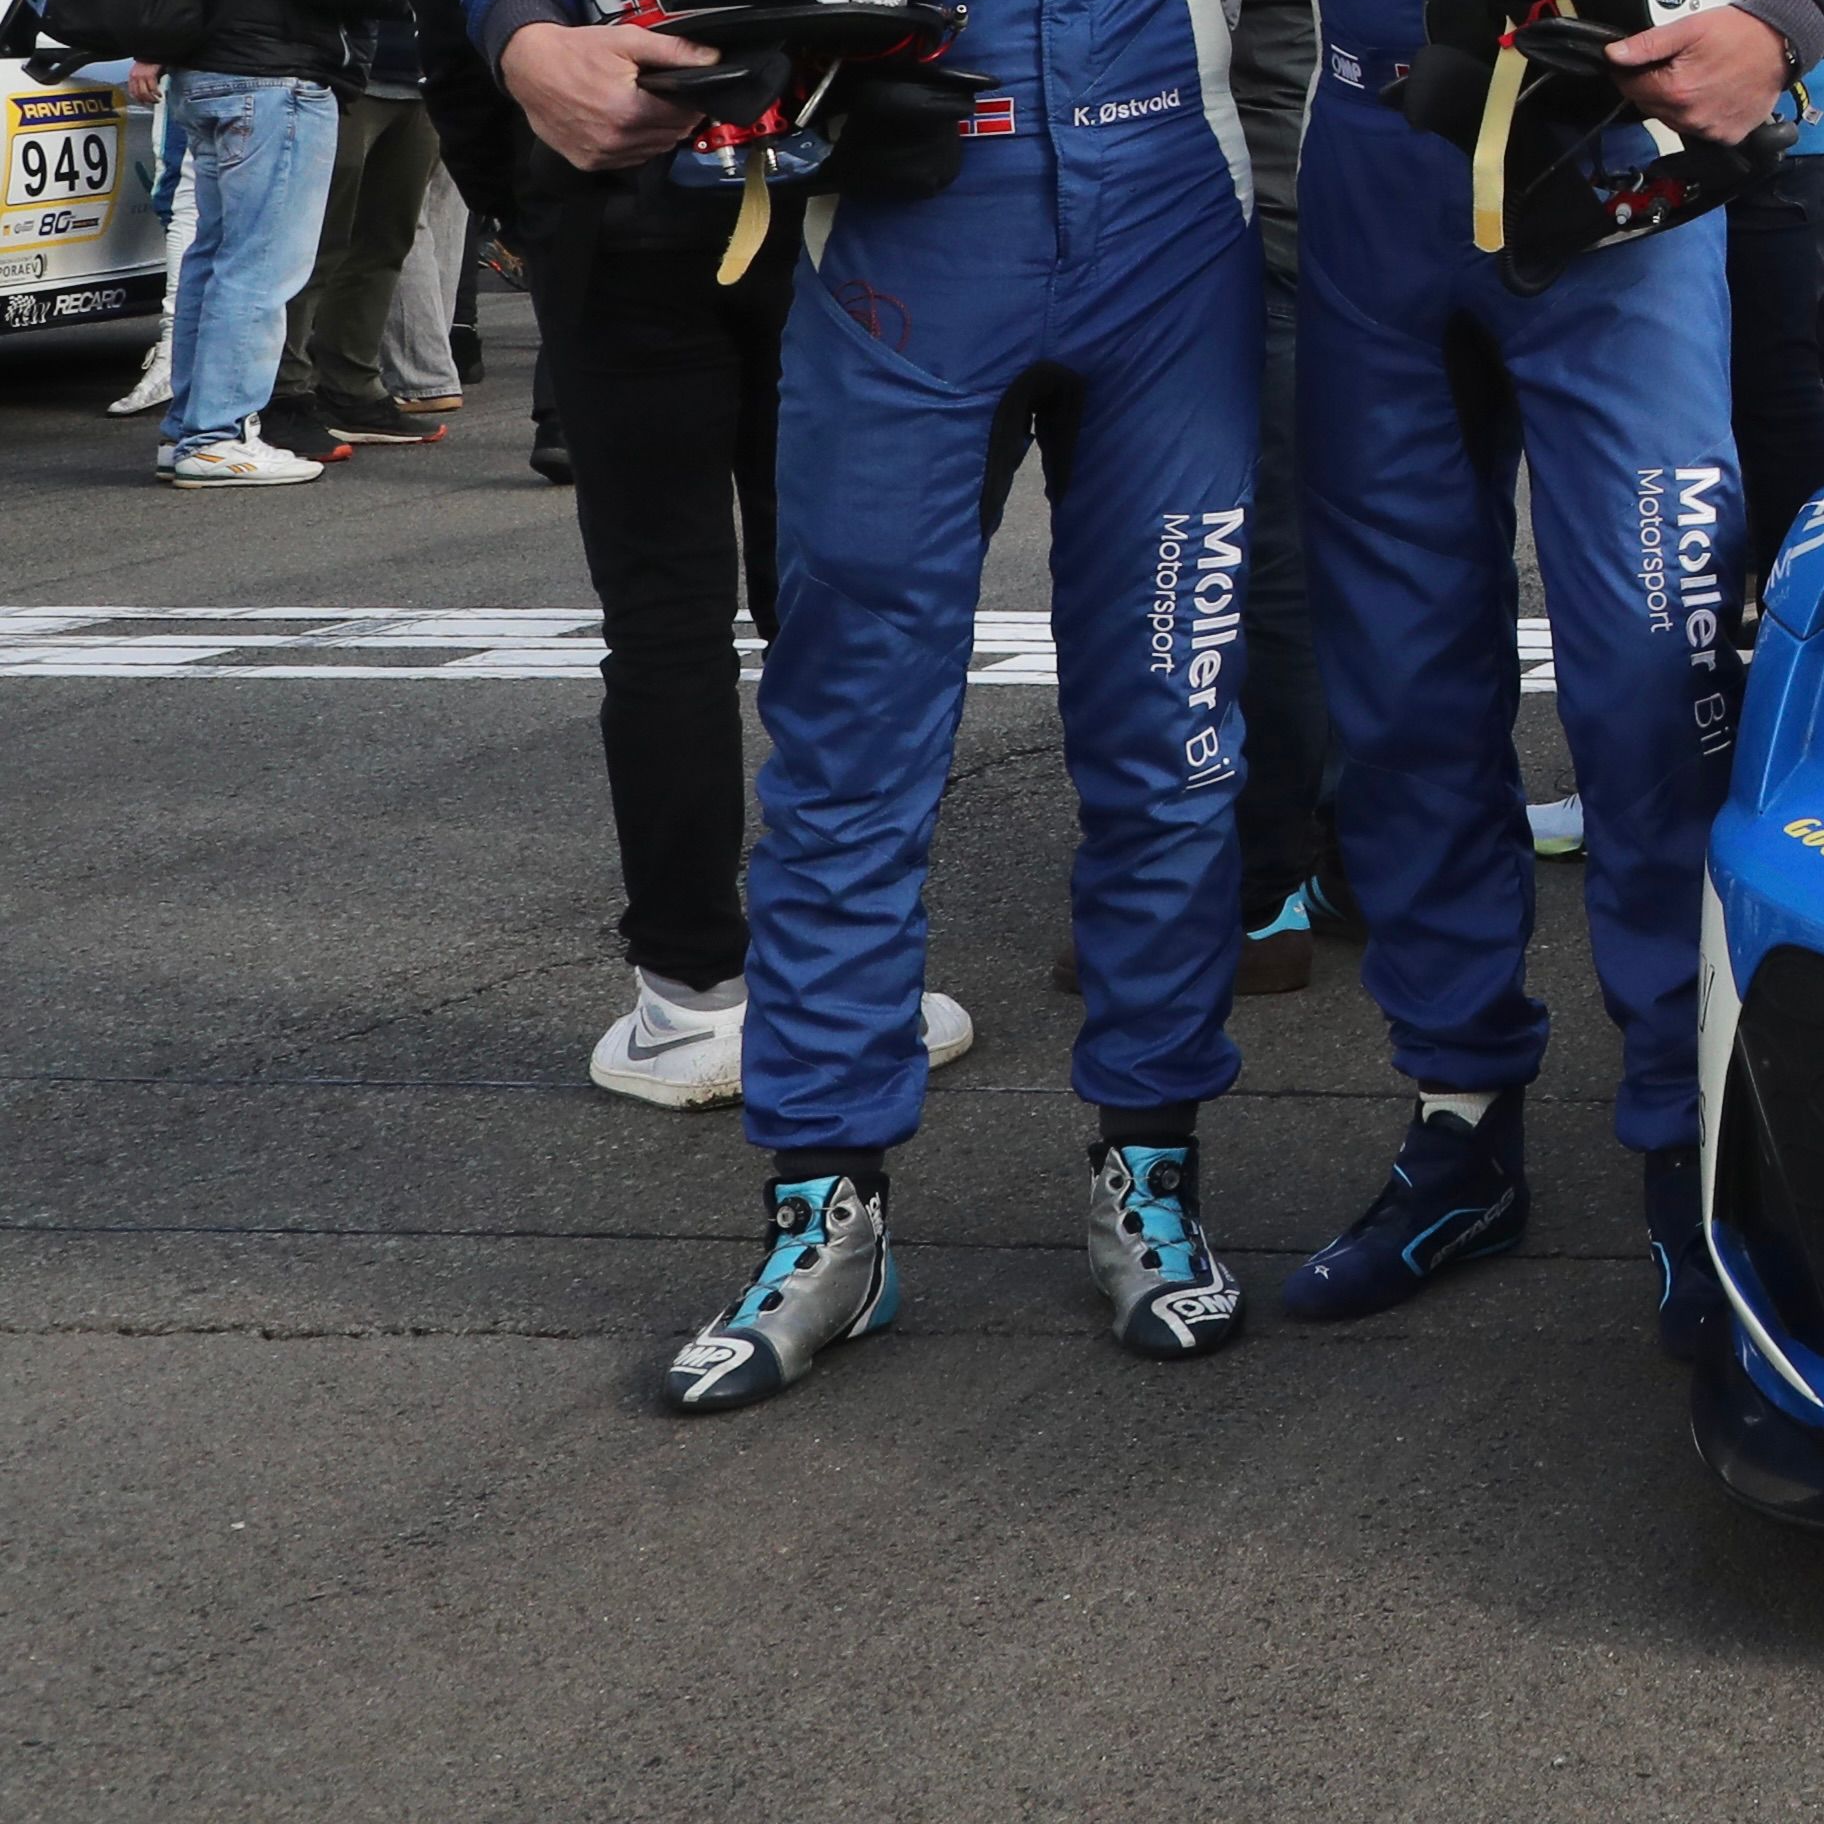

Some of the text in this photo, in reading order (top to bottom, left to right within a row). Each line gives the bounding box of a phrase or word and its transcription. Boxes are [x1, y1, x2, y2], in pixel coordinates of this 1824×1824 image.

[1331, 54, 1362, 82] OMP
[23, 94, 113, 120] RAVENOL
[1073, 88, 1181, 127] K. Østvold
[21, 133, 110, 198] 949
[53, 288, 127, 316] RECARO
[1635, 469, 1674, 634] Motorsport
[1146, 513, 1190, 676] Motorsport
[1693, 691, 1732, 758] Bil
[1184, 726, 1237, 793] Bil
